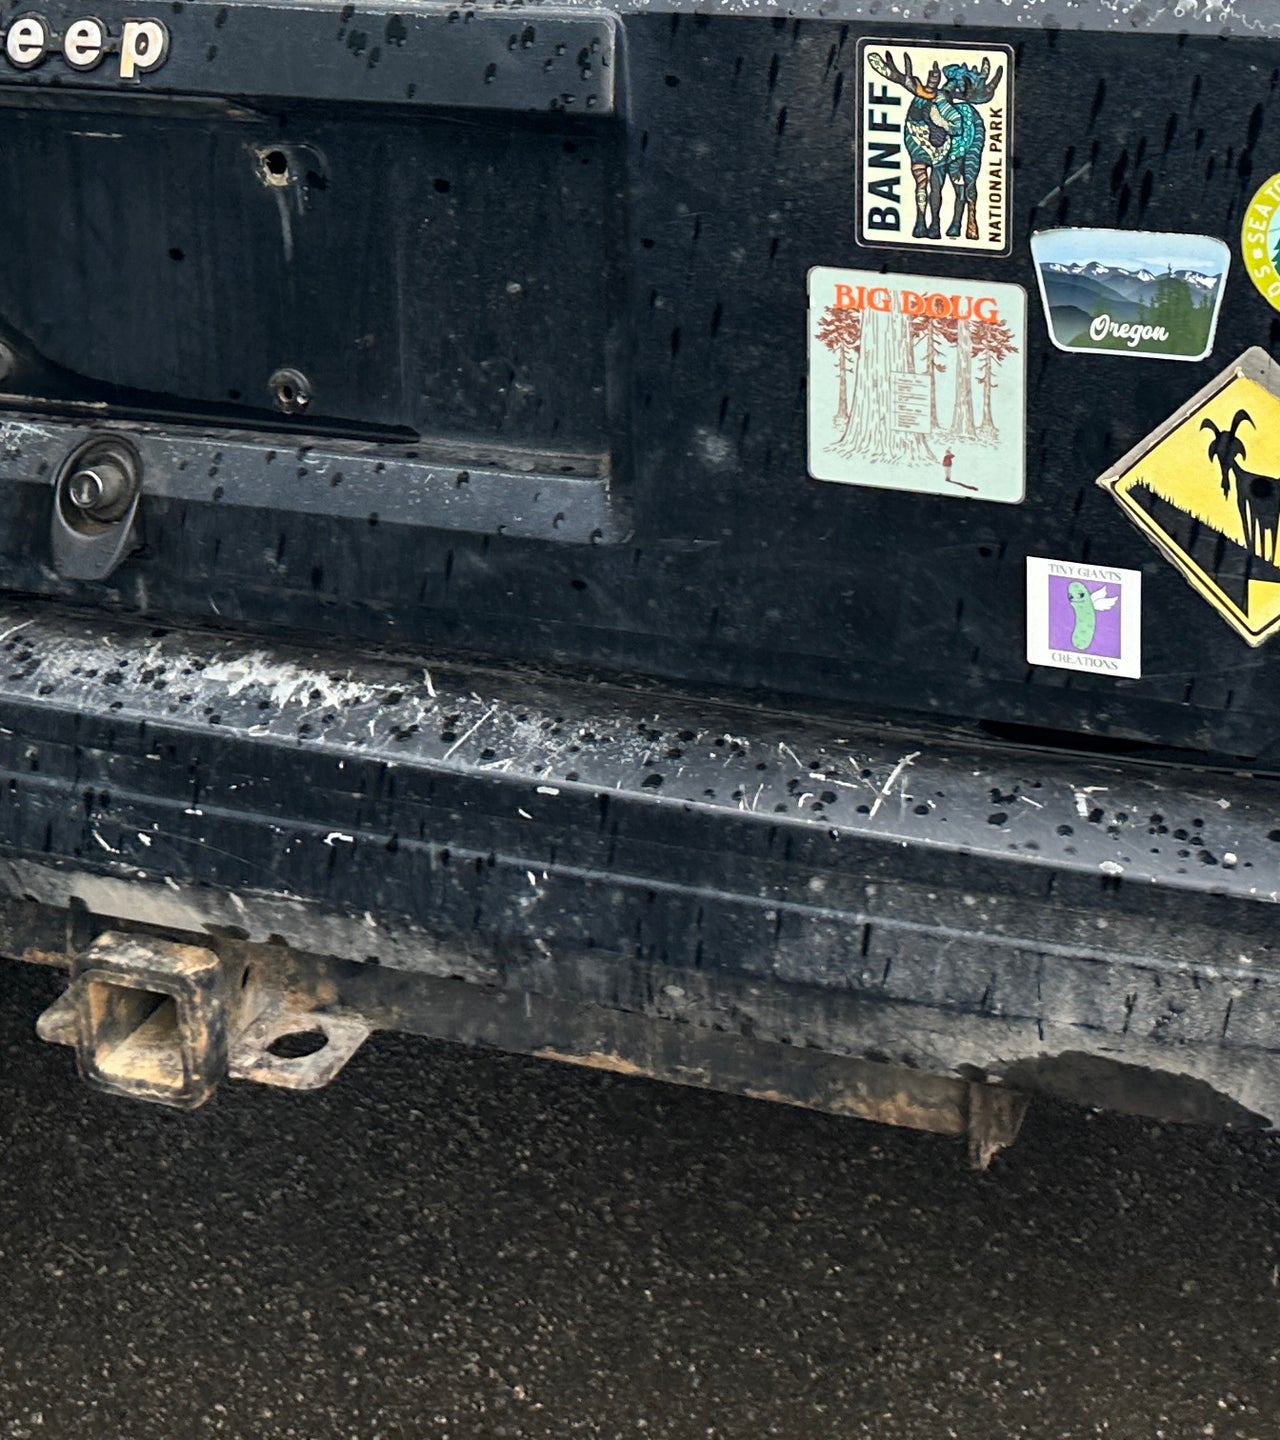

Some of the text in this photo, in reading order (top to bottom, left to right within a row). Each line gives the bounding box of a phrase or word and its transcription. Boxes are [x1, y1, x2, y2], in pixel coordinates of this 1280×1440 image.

[868, 81, 901, 232] BANFF
[988, 107, 1003, 243] NATIONAL PARK
[1247, 203, 1273, 244] SEA
[834, 284, 999, 324] BIG DOUG
[1089, 314, 1169, 348] Oregon
[1048, 563, 1122, 582] TINY GIANTS
[1051, 652, 1118, 670] CREATIONS
